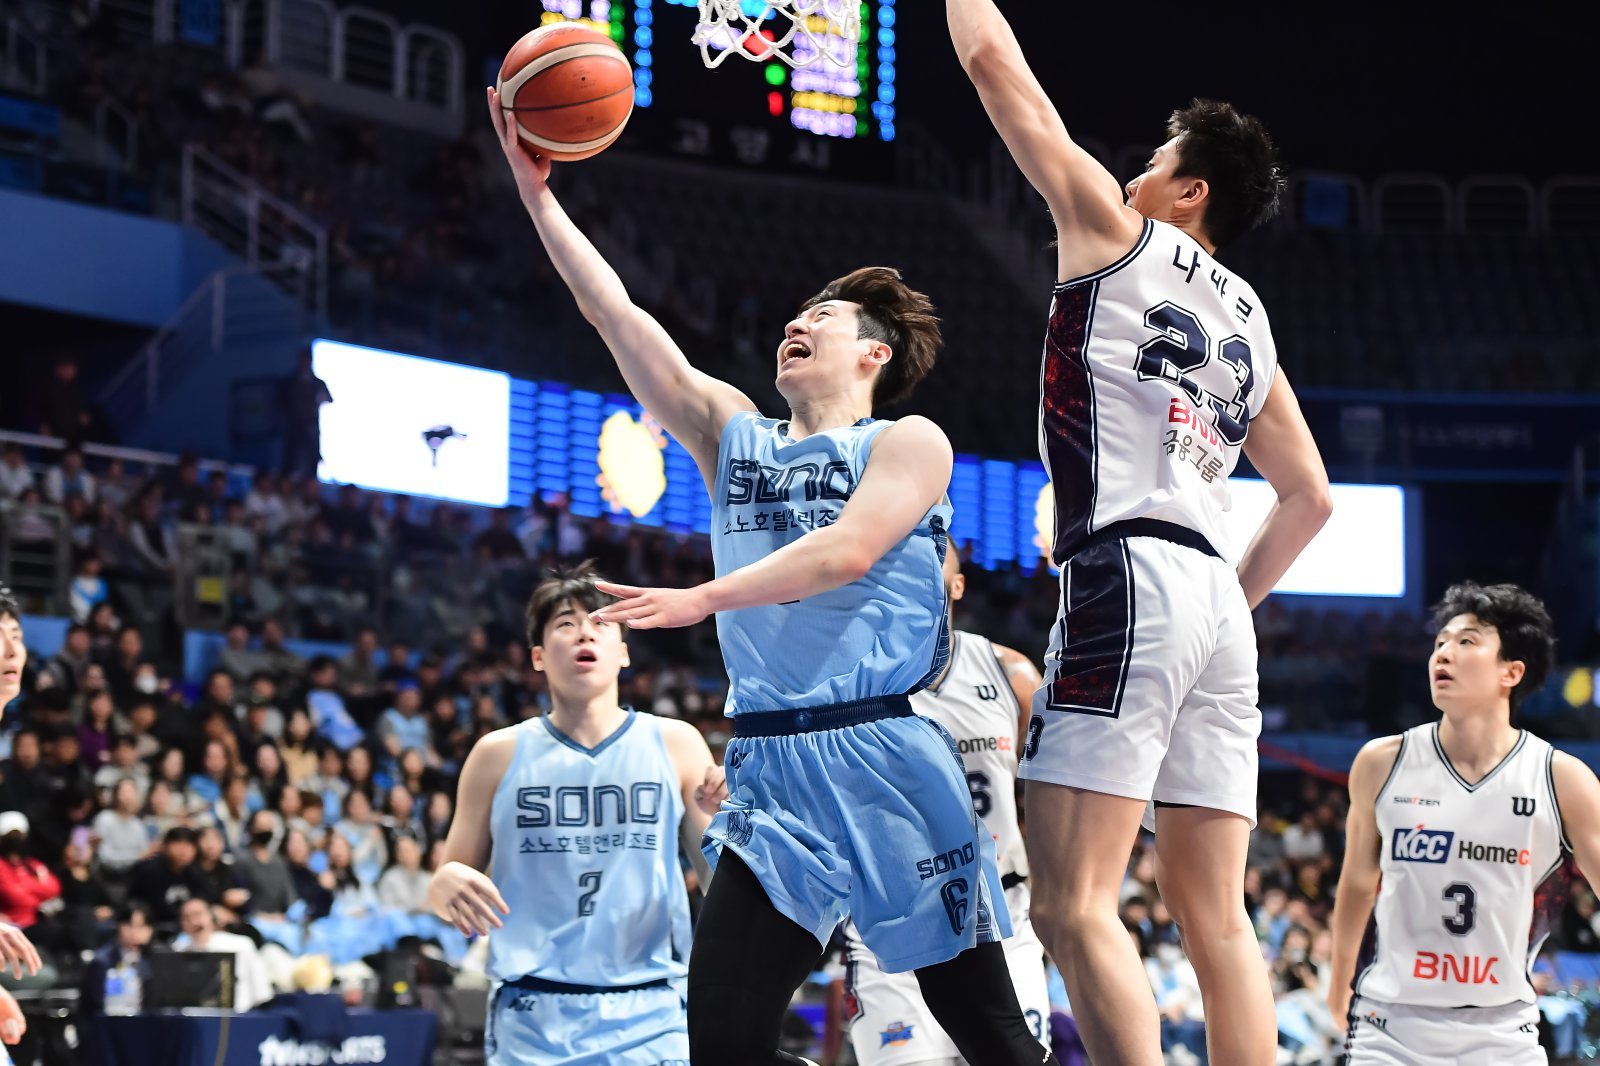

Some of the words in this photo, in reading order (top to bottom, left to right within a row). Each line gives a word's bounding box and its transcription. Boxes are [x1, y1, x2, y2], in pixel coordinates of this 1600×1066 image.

[1133, 300, 1254, 446] 23
[1163, 429, 1224, 484] 금융그룹
[723, 508, 837, 536] 소노호텔앤리조
[519, 831, 658, 855] 소노호텔앤리조트
[1394, 826, 1450, 861] KCC
[1458, 840, 1531, 866] Homec
[577, 870, 603, 918] 2
[940, 877, 969, 936] 6
[1441, 881, 1477, 938] 3
[1413, 951, 1499, 985] BNK
